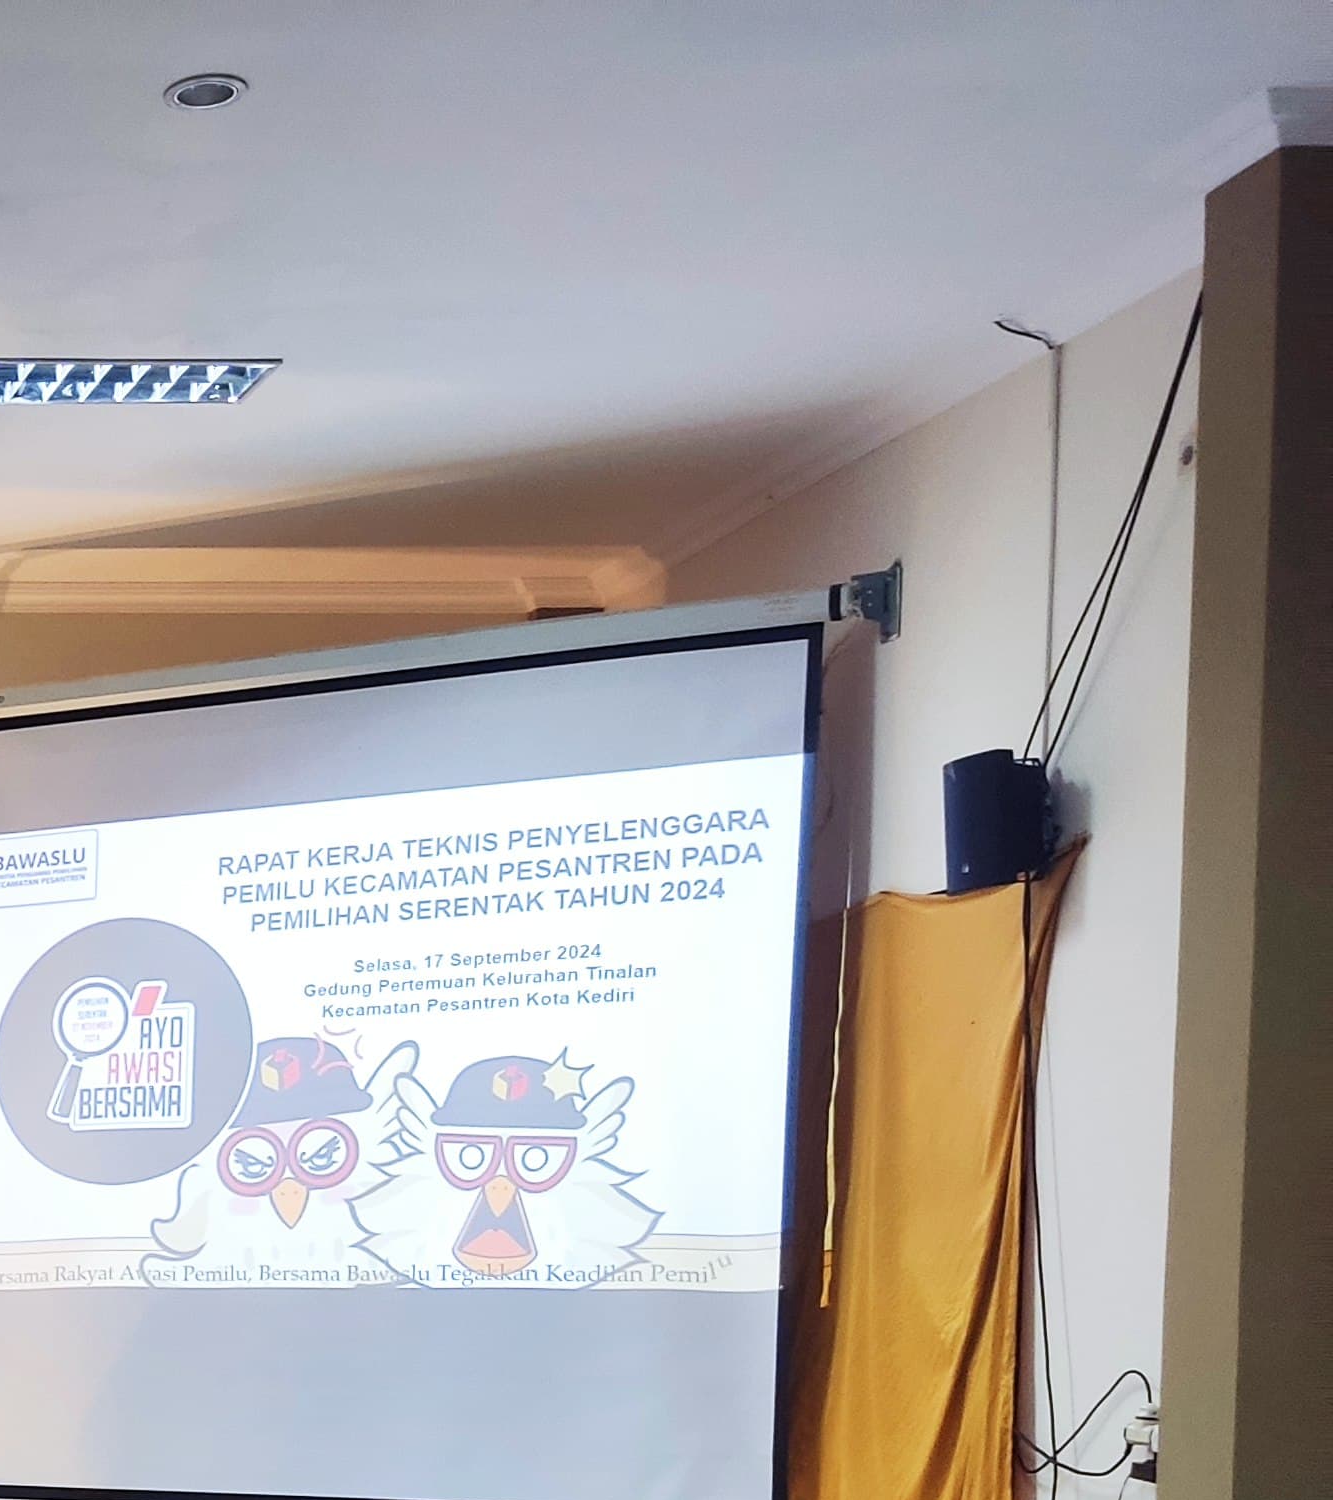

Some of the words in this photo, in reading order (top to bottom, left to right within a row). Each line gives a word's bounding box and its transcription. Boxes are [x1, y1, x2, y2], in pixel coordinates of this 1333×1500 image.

[218, 850, 300, 875] RAPAT
[307, 842, 393, 868] KERJA
[402, 832, 498, 859] TEKNIS
[508, 808, 770, 850] PENYELENGGARA
[223, 879, 315, 904] PEMILU
[324, 864, 488, 896] KECAMATAN
[499, 849, 671, 882] PESANTREN
[682, 842, 763, 868] PADA
[251, 903, 389, 932] PEMILIHAN
[398, 891, 545, 921] SERENTAK
[555, 883, 650, 909] TAHUN
[660, 877, 725, 902] 2024
[354, 957, 417, 973] Selasa,
[424, 954, 444, 969] 17
[450, 949, 551, 971] September
[557, 944, 602, 961] 2024
[304, 981, 372, 998] Gedung
[379, 976, 476, 993] Pertemuan
[483, 969, 578, 988] Kelurahan
[587, 964, 657, 981] Tinalan
[322, 1002, 420, 1018] Kecamatan
[427, 996, 520, 1013] Pesantren
[527, 992, 570, 1007] Kota
[577, 987, 636, 1005] Kediri
[140, 1016, 183, 1049] AYO
[108, 1051, 182, 1084] AWASI
[79, 1085, 182, 1120] BERSAMA
[54, 1265, 114, 1287] Rakyat
[183, 1264, 252, 1283] Pemilu,
[259, 1264, 341, 1282] Bersama
[346, 1264, 430, 1282] Bawaslu
[437, 1264, 539, 1287] Tegakkan
[545, 1264, 644, 1283] Keadilan
[650, 1254, 733, 1284] Pemilu
